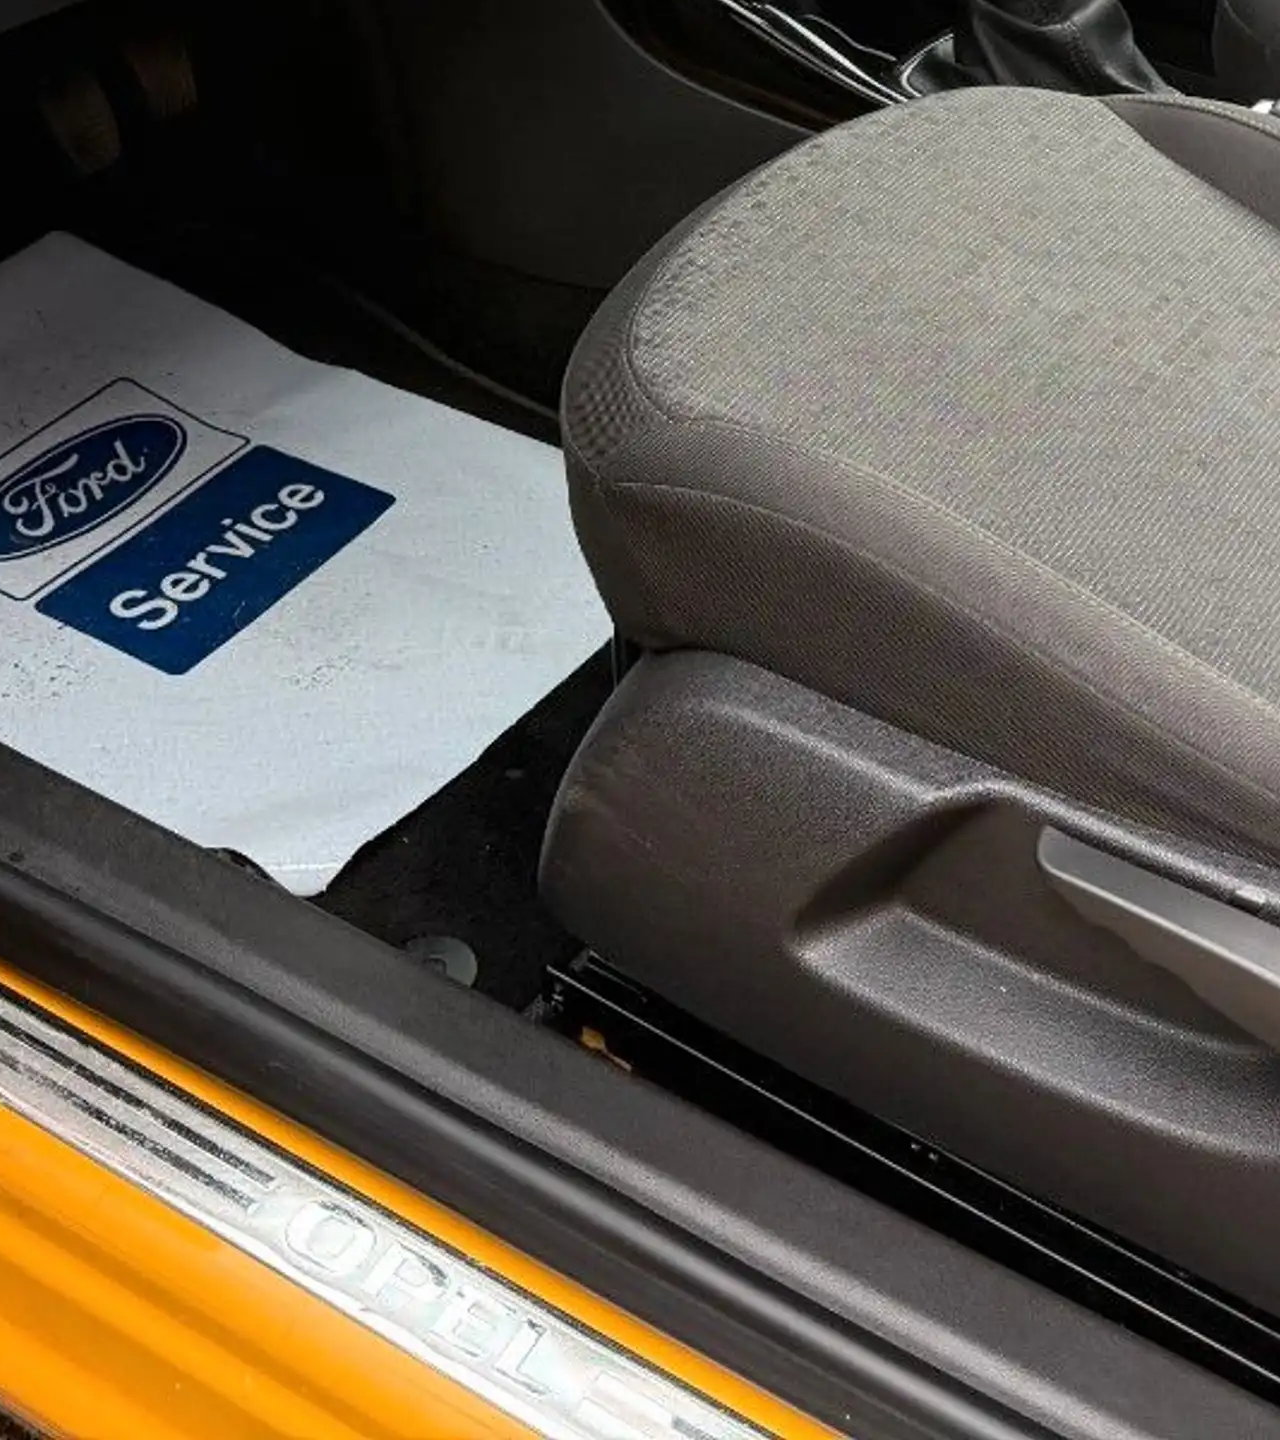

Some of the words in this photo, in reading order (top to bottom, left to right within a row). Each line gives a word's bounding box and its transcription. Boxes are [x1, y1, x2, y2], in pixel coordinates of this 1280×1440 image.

[3, 439, 147, 537] Ford
[109, 483, 325, 630] Service
[284, 1200, 556, 1396] OPEL
